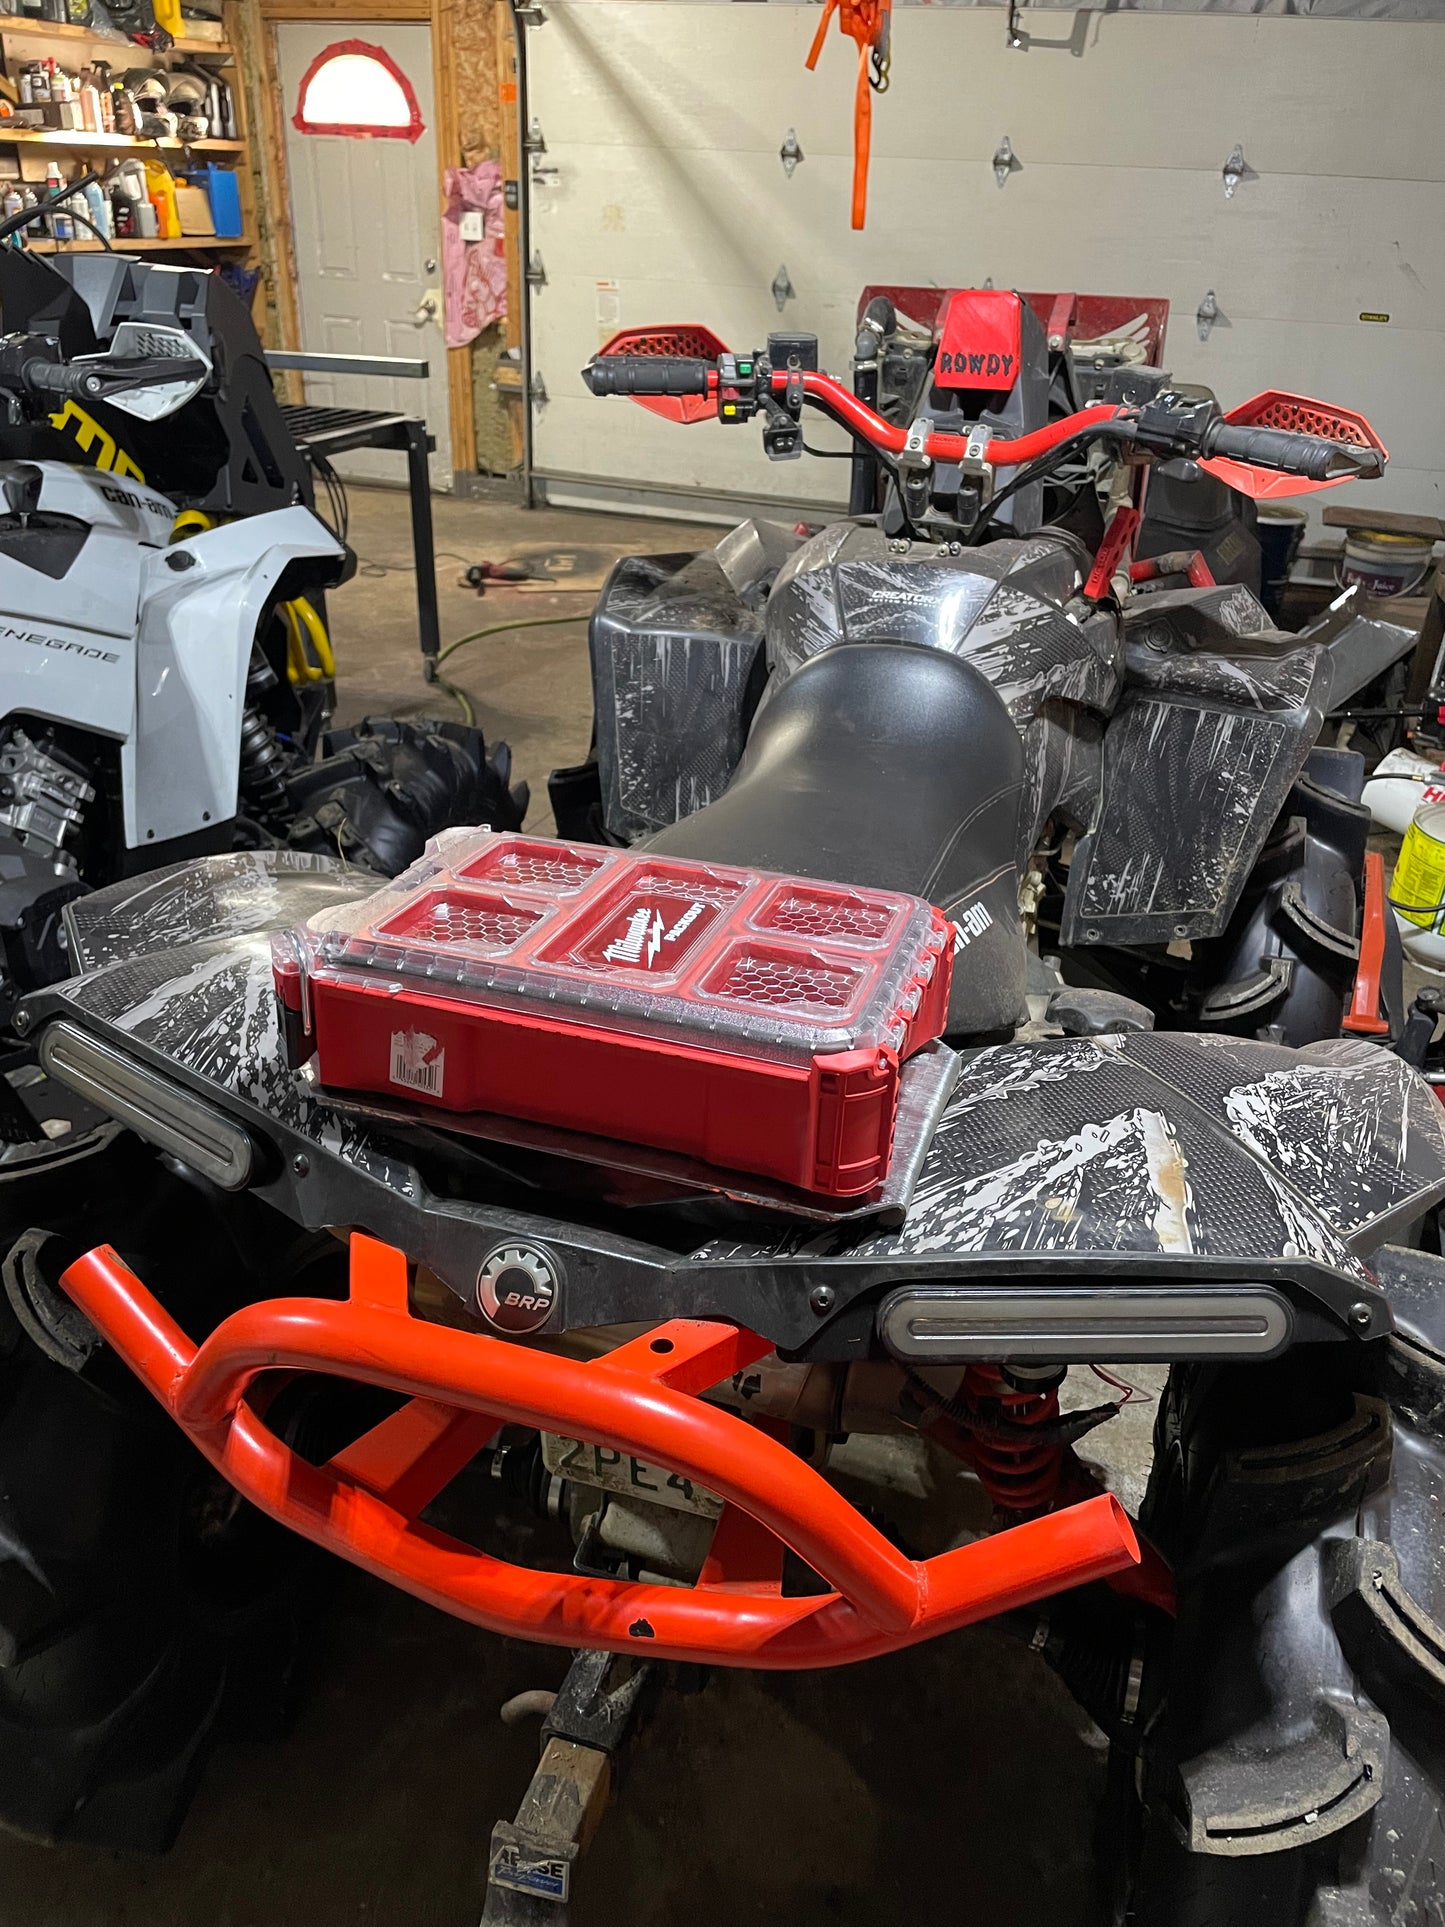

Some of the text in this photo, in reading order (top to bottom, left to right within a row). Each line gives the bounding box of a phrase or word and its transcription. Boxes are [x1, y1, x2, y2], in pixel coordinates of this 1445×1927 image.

[940, 352, 1013, 377] ROWDY
[100, 486, 175, 520] can-am
[602, 908, 651, 962] Milwaukee
[664, 902, 706, 941] PACKOUT
[504, 1292, 550, 1311] BRP
